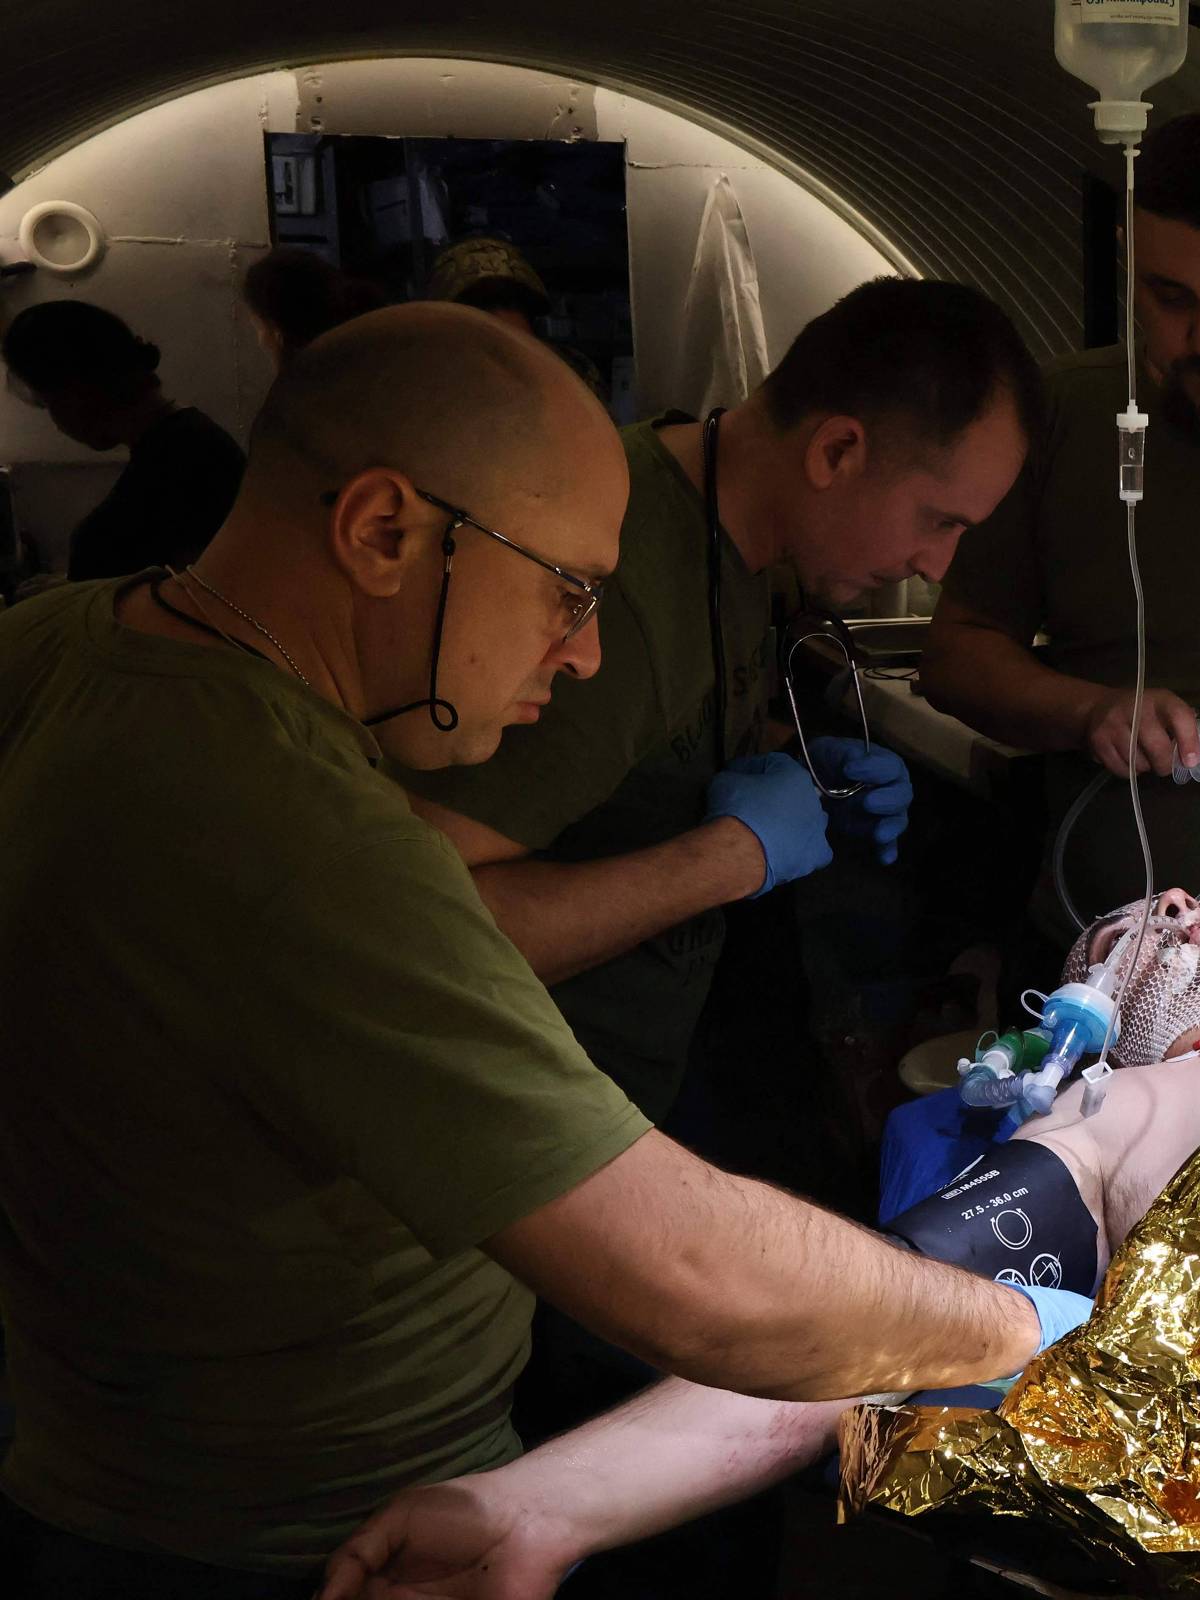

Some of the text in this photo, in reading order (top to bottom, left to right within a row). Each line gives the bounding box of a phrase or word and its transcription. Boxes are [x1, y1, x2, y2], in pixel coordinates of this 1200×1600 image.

[960, 1169, 1000, 1191] M4555B
[961, 1205, 985, 1220] 27.5
[990, 1193, 1011, 1207] 36.0
[1012, 1187, 1029, 1198] cm
